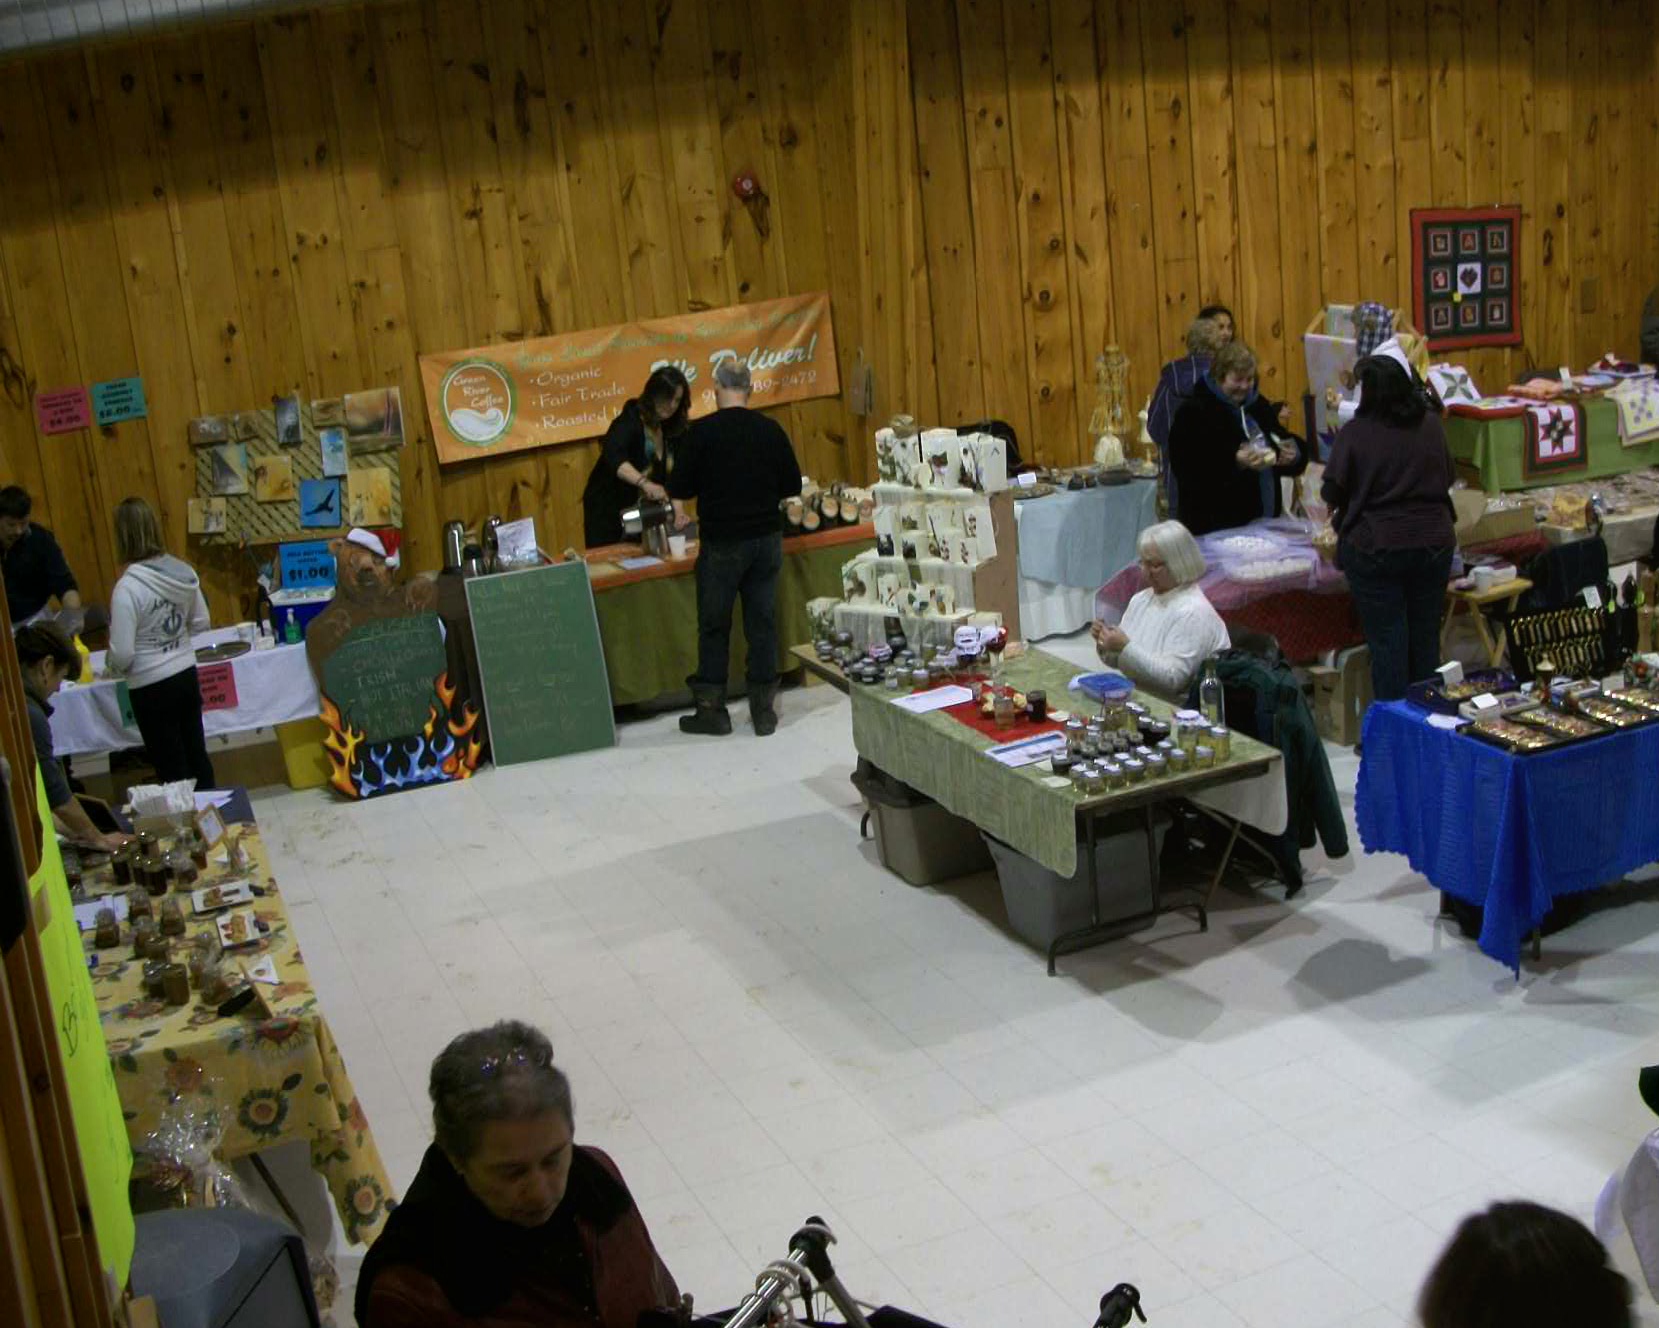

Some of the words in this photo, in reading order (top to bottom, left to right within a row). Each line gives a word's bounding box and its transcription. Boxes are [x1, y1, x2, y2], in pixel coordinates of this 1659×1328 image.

[710, 334, 818, 380] Dliver!
[453, 375, 487, 388] Green
[536, 366, 602, 387] Organic
[463, 385, 491, 398] River
[541, 393, 572, 409] Fair
[576, 381, 626, 402] Trade
[471, 395, 505, 409] Coffee
[543, 406, 608, 429] Roasted
[289, 566, 329, 582] $1.00
